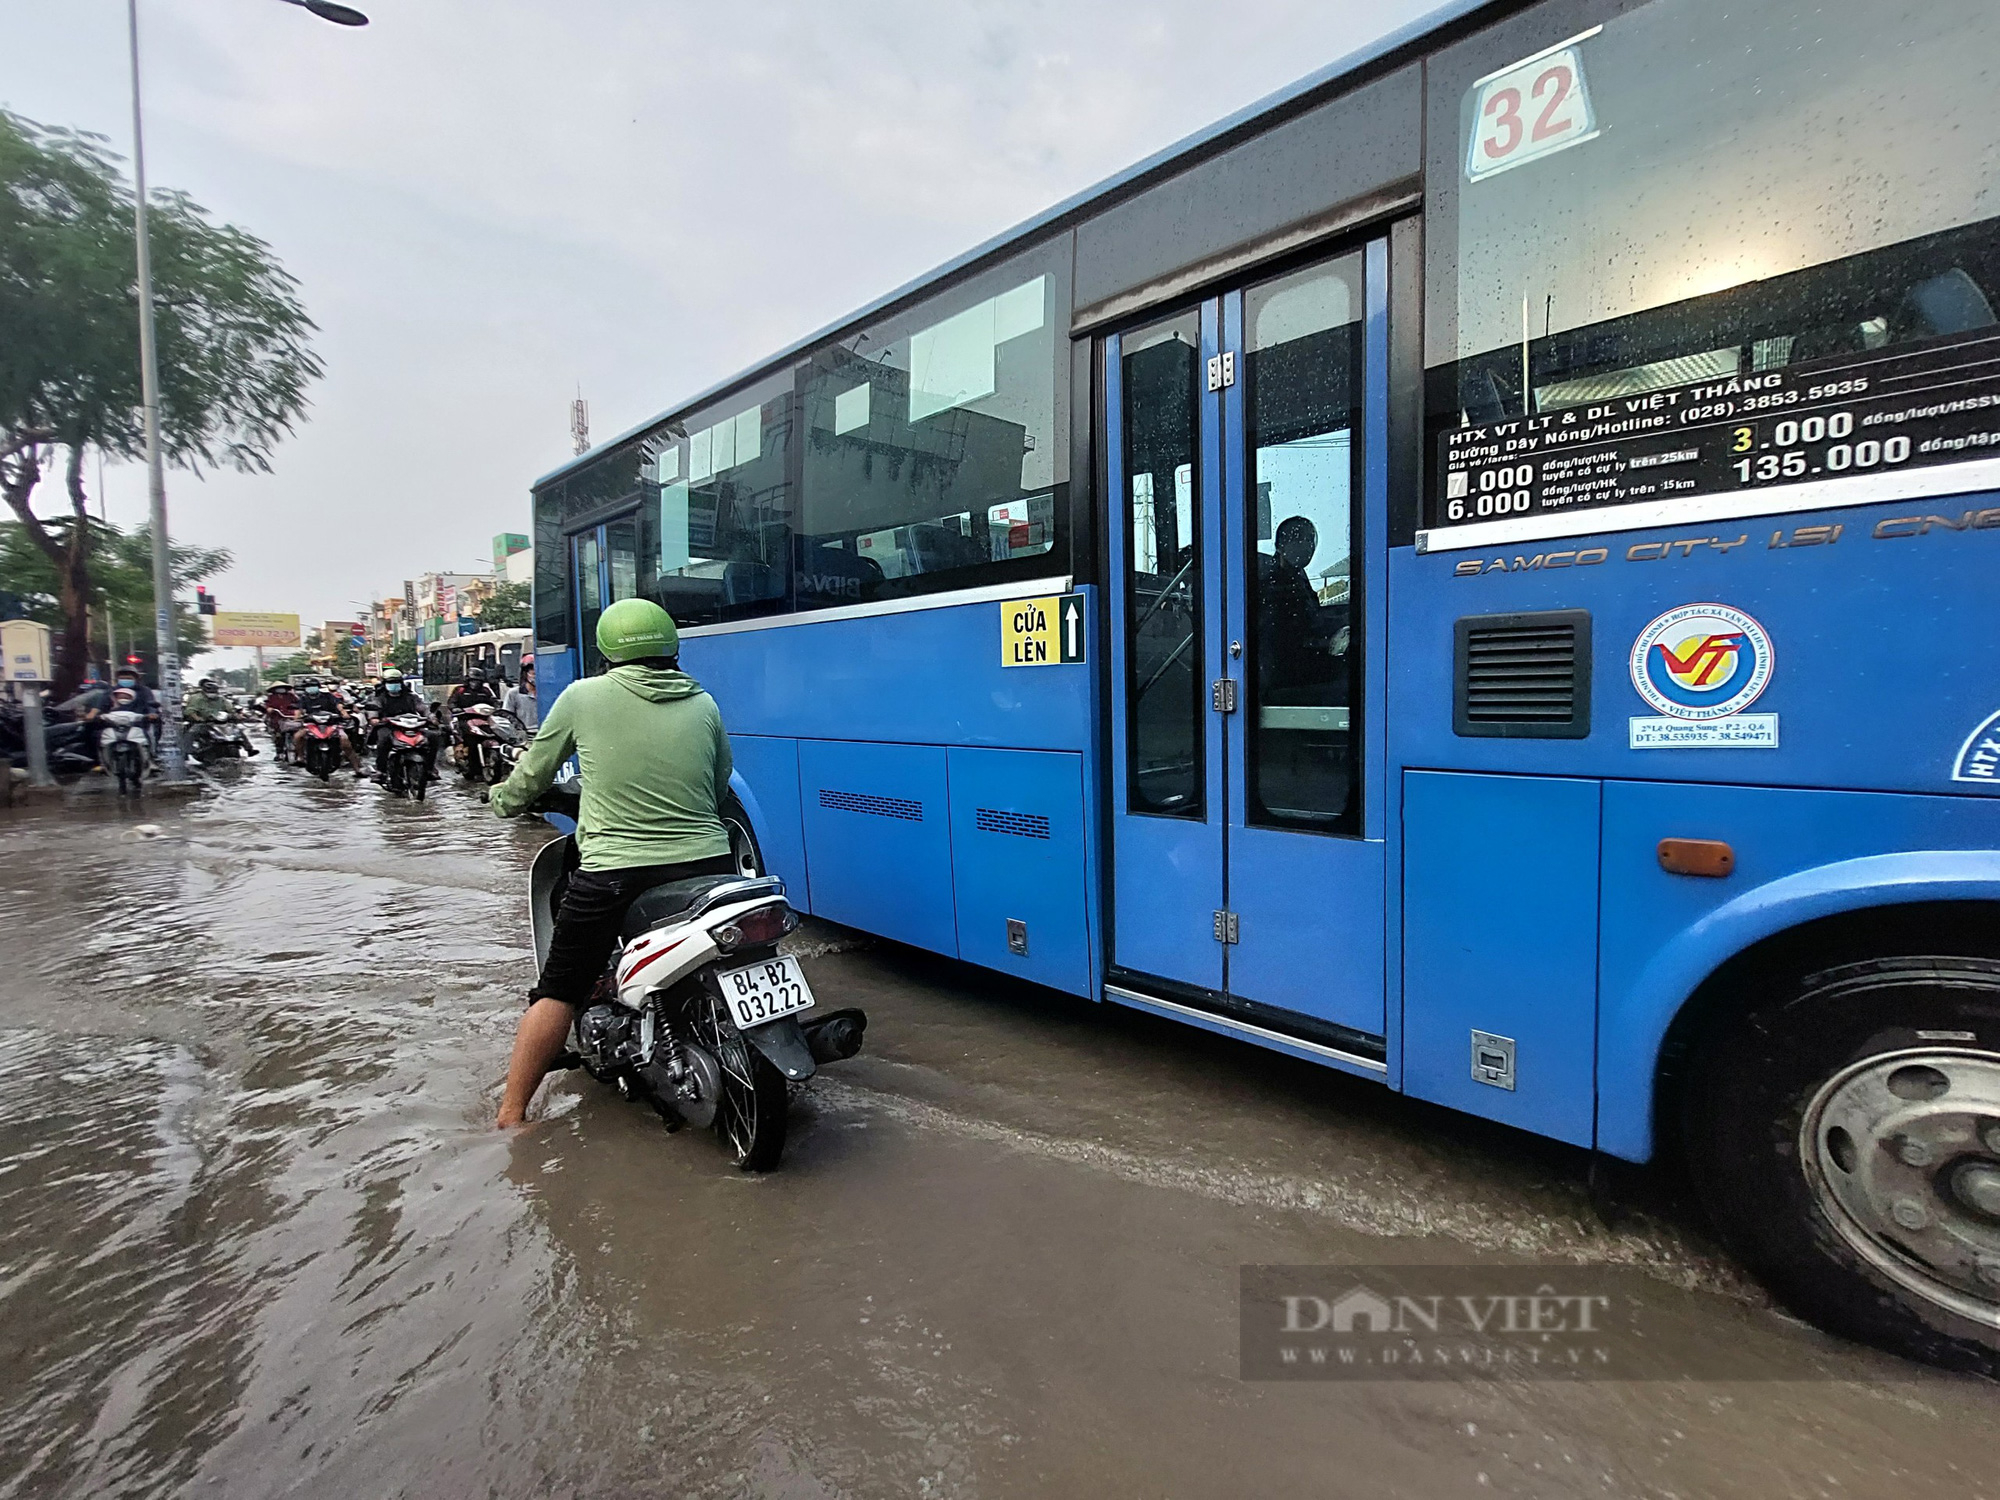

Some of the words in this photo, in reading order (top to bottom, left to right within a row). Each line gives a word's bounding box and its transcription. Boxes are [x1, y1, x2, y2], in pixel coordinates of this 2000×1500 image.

[1483, 64, 1573, 159] 32
[1448, 443, 1499, 462] Đường
[1506, 436, 1539, 453] Dây
[1544, 414, 1672, 446] Nóng/Hotline:
[1679, 377, 1869, 424] (028).3853.5935
[1449, 427, 1488, 446] HTX
[1494, 420, 1521, 438] VT
[1528, 415, 1553, 431] LT
[1561, 411, 1578, 425] &
[1587, 404, 1617, 421] DL
[1625, 391, 1682, 413] VIỆT
[1690, 373, 1783, 402] THẮNG
[1731, 411, 1854, 453] 3.000
[1732, 435, 1911, 484] 135.000
[1448, 464, 1533, 498] 7.000
[1448, 489, 1531, 520] 6.000
[1453, 547, 1609, 578] SAMCO
[1626, 533, 1748, 562] CITY
[1013, 603, 1047, 634] CỬA
[1014, 635, 1047, 663] LÊN
[733, 961, 792, 995] 84-B2
[737, 983, 807, 1023] 032.22
